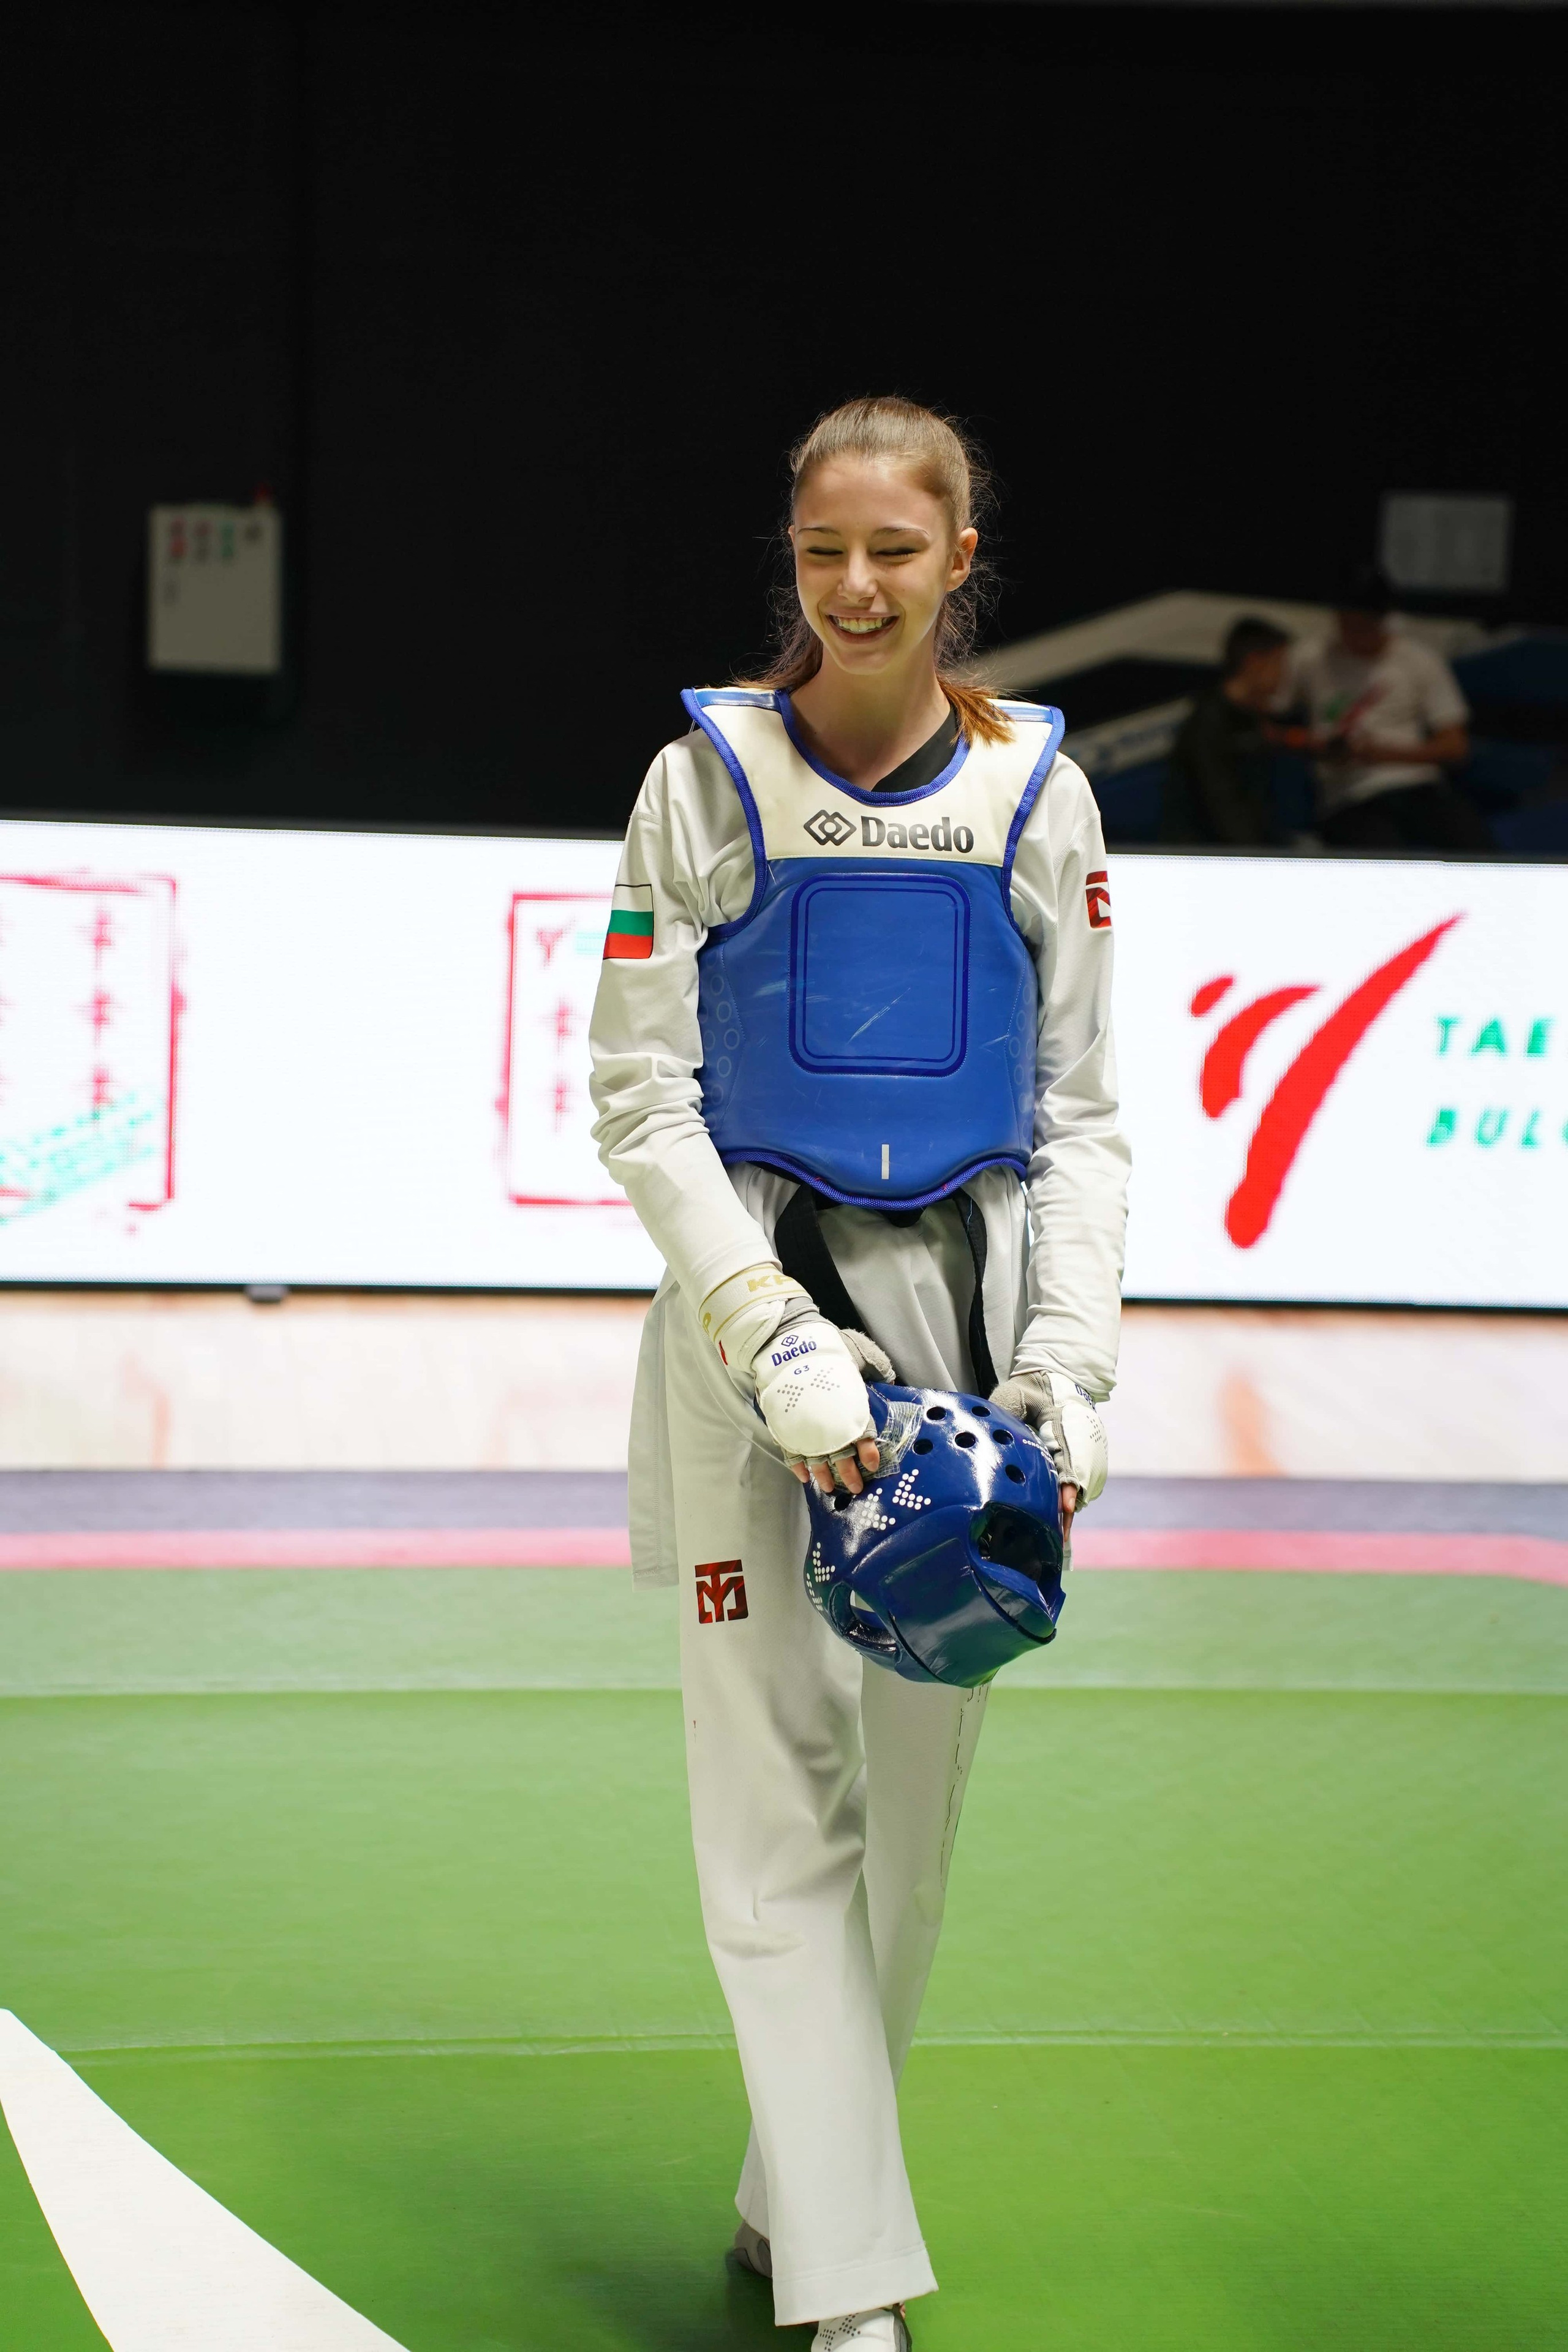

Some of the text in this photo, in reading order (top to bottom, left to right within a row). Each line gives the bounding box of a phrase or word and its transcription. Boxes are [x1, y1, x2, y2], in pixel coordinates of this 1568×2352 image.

[861, 815, 974, 853] Daedo
[1427, 1106, 1568, 1147] BUL
[771, 1340, 817, 1366] Daedo
